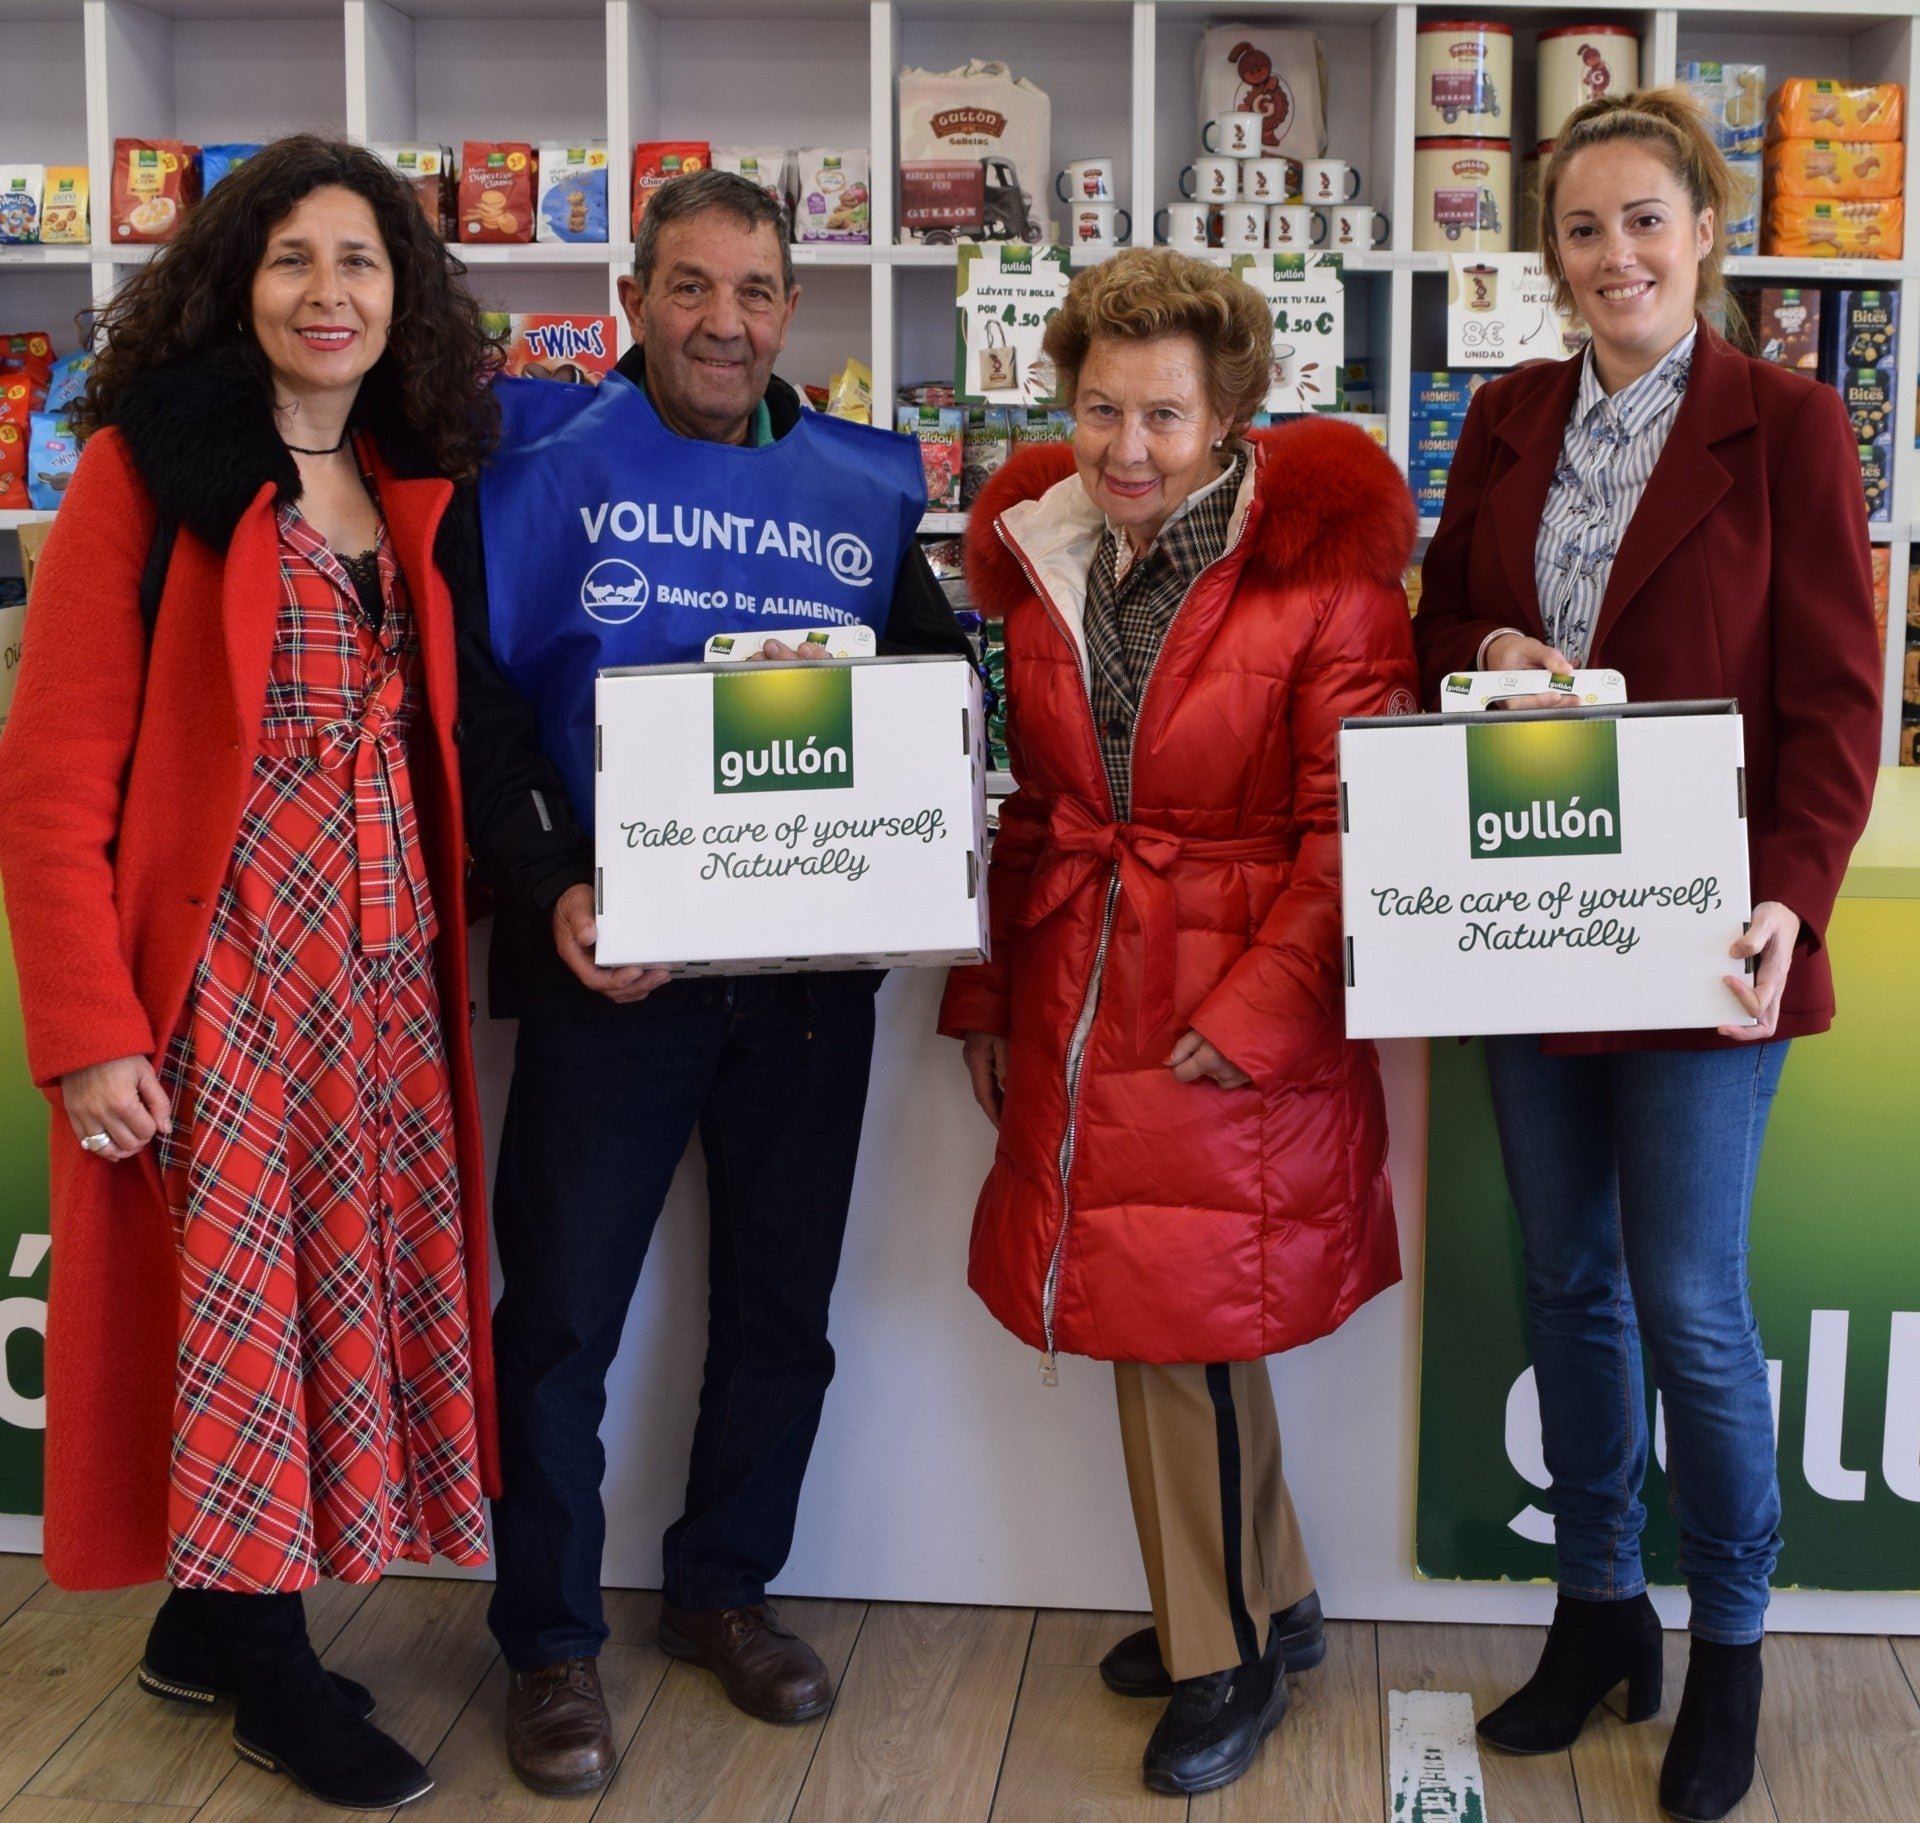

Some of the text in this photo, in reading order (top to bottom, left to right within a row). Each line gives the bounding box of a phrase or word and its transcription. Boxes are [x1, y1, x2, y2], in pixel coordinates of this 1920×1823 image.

[1001, 261, 1031, 273] gullón
[1274, 269, 1304, 281] gullón
[977, 285, 1013, 296] LLÉVATE
[1029, 289, 1055, 297] BOLSA
[1291, 296, 1302, 304] TU
[1304, 296, 1326, 304] TAZA
[1523, 294, 1537, 302] DE
[978, 305, 997, 314] POR
[1852, 310, 1887, 323] Bites
[525, 321, 604, 358] TWINS
[1463, 321, 1505, 346] 8€
[1465, 351, 1504, 359] UNIDAD
[1848, 387, 1884, 400] Bites
[580, 501, 874, 587] VOLUNTARI@
[657, 584, 862, 626] BANCO DE ALIMENTOS
[1447, 683, 1470, 694] gullón
[1549, 681, 1572, 691] gullón
[720, 736, 848, 787] gullón
[620, 808, 948, 849] Take care of yourself,
[1477, 796, 1614, 851] gullón
[700, 847, 871, 882] Naturally
[1370, 876, 1723, 919] Take care of yourself,
[1458, 918, 1640, 955] Naturally
